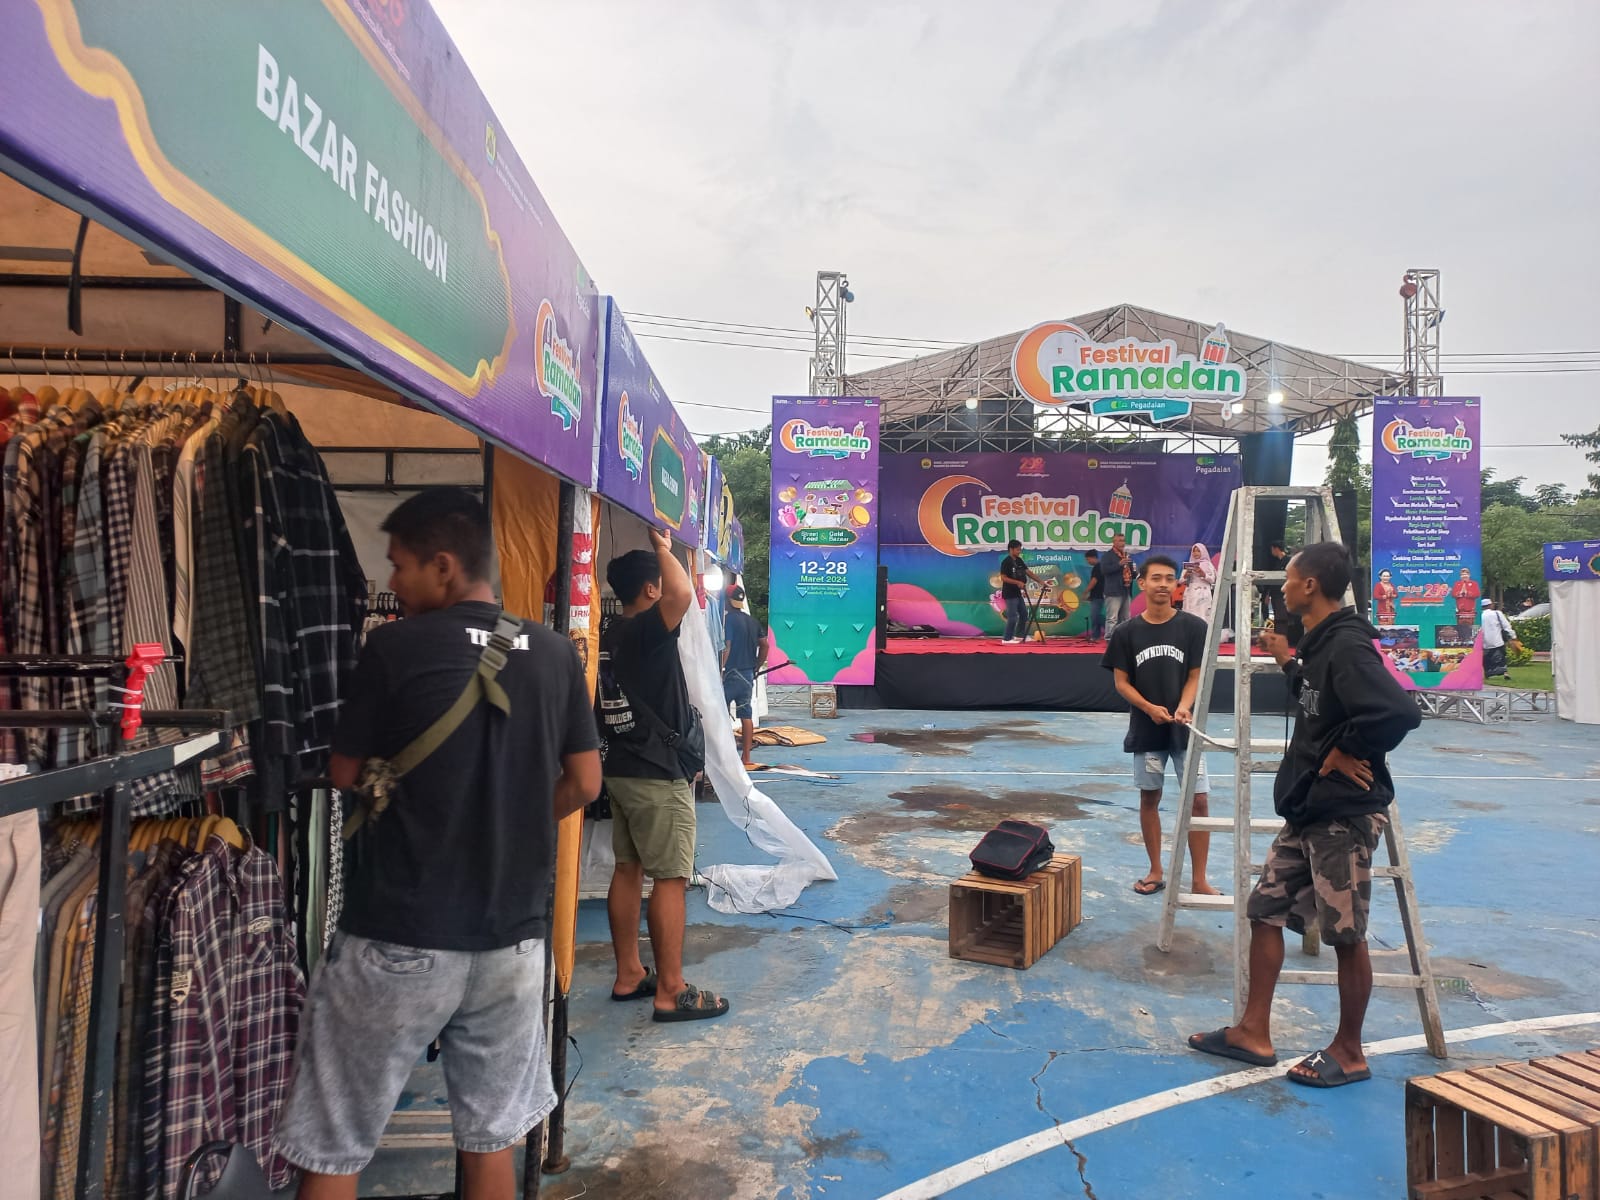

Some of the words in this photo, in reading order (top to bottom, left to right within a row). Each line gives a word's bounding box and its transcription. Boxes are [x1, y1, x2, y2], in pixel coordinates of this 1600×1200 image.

[256, 43, 357, 200] BAZAR
[364, 160, 447, 283] FASHION
[1080, 344, 1171, 365] Festival
[544, 350, 580, 410] Ramadan
[1052, 361, 1241, 393] Ramadan
[1408, 429, 1443, 437] Festival
[795, 436, 869, 448] Ramadan
[1397, 437, 1470, 448] Ramadan
[1195, 466, 1231, 474] Pegadaian
[985, 496, 1076, 517] Festival
[956, 514, 1148, 547] Ramadan
[1036, 554, 1072, 562] Pegadaian
[799, 561, 848, 574] 12-28
